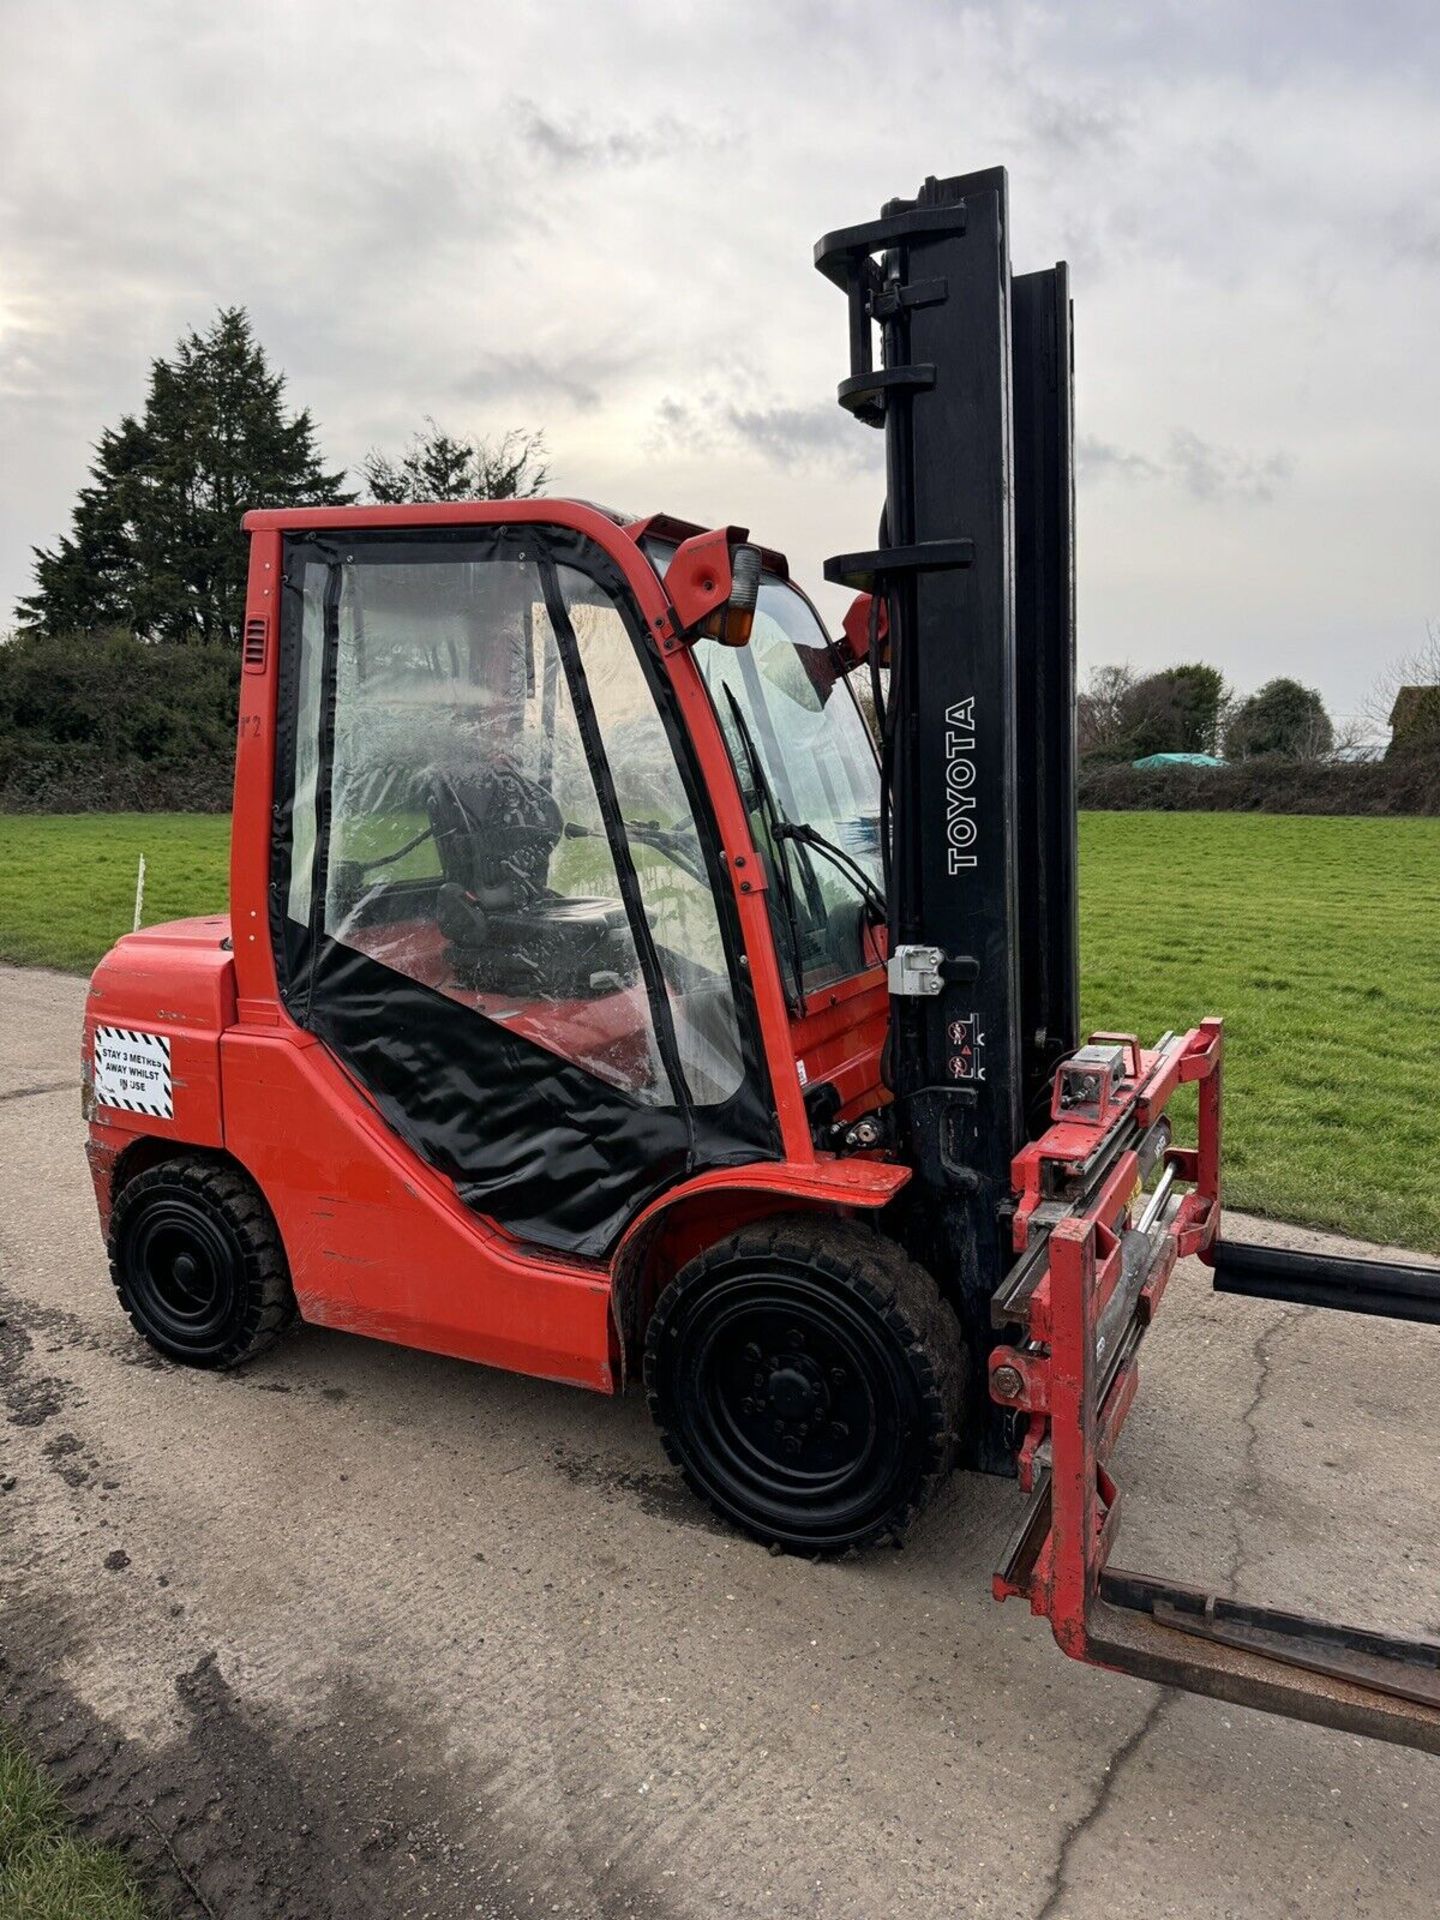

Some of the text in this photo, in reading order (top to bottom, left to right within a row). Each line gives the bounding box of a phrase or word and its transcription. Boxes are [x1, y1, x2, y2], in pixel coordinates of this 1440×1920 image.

[946, 696, 977, 875] TOYOTA
[102, 1048, 121, 1059] STAY
[123, 1052, 128, 1061] 3
[105, 1062, 159, 1081] AWAY WHILST
[130, 1081, 146, 1092] USE
